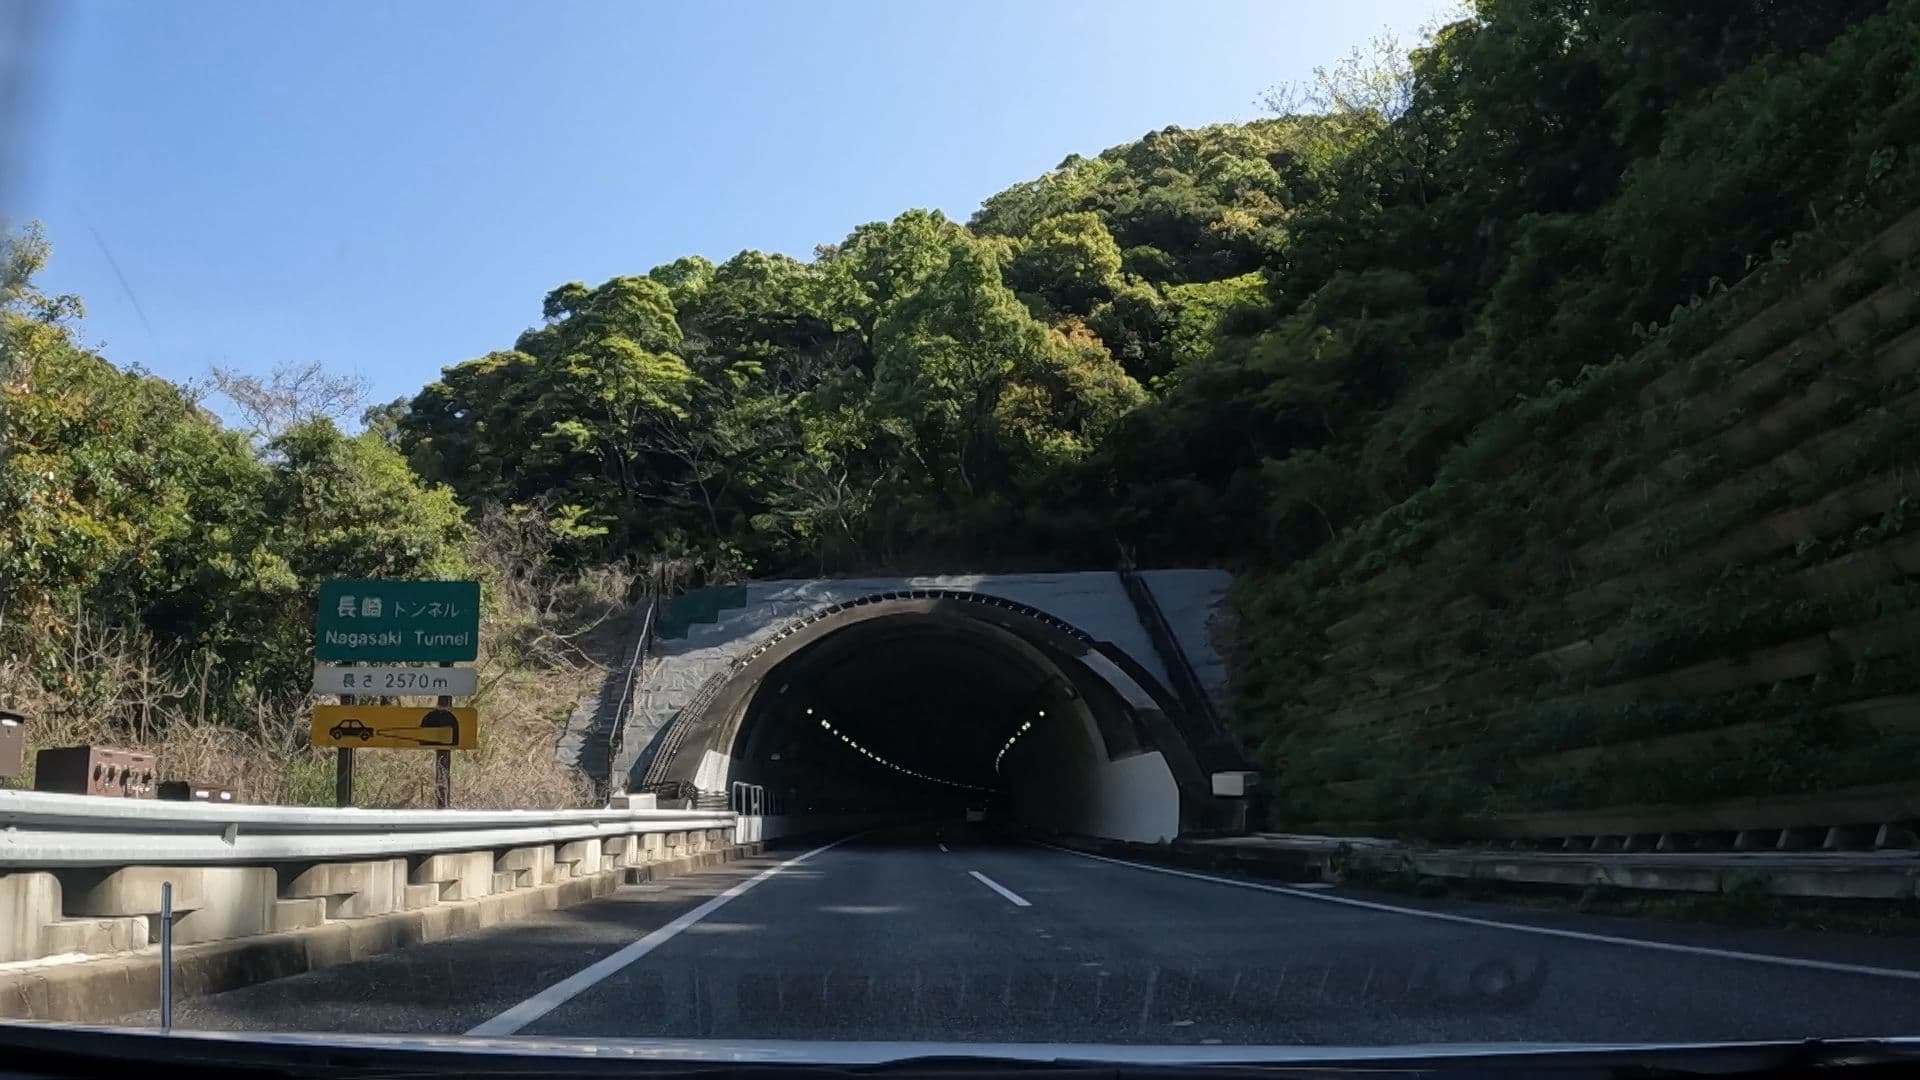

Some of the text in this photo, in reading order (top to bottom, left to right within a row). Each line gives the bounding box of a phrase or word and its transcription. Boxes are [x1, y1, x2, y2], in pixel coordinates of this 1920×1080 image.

[394, 602, 460, 618] トンネル
[325, 630, 469, 648] Nagasaki Tunnel
[343, 673, 372, 688] 長さ
